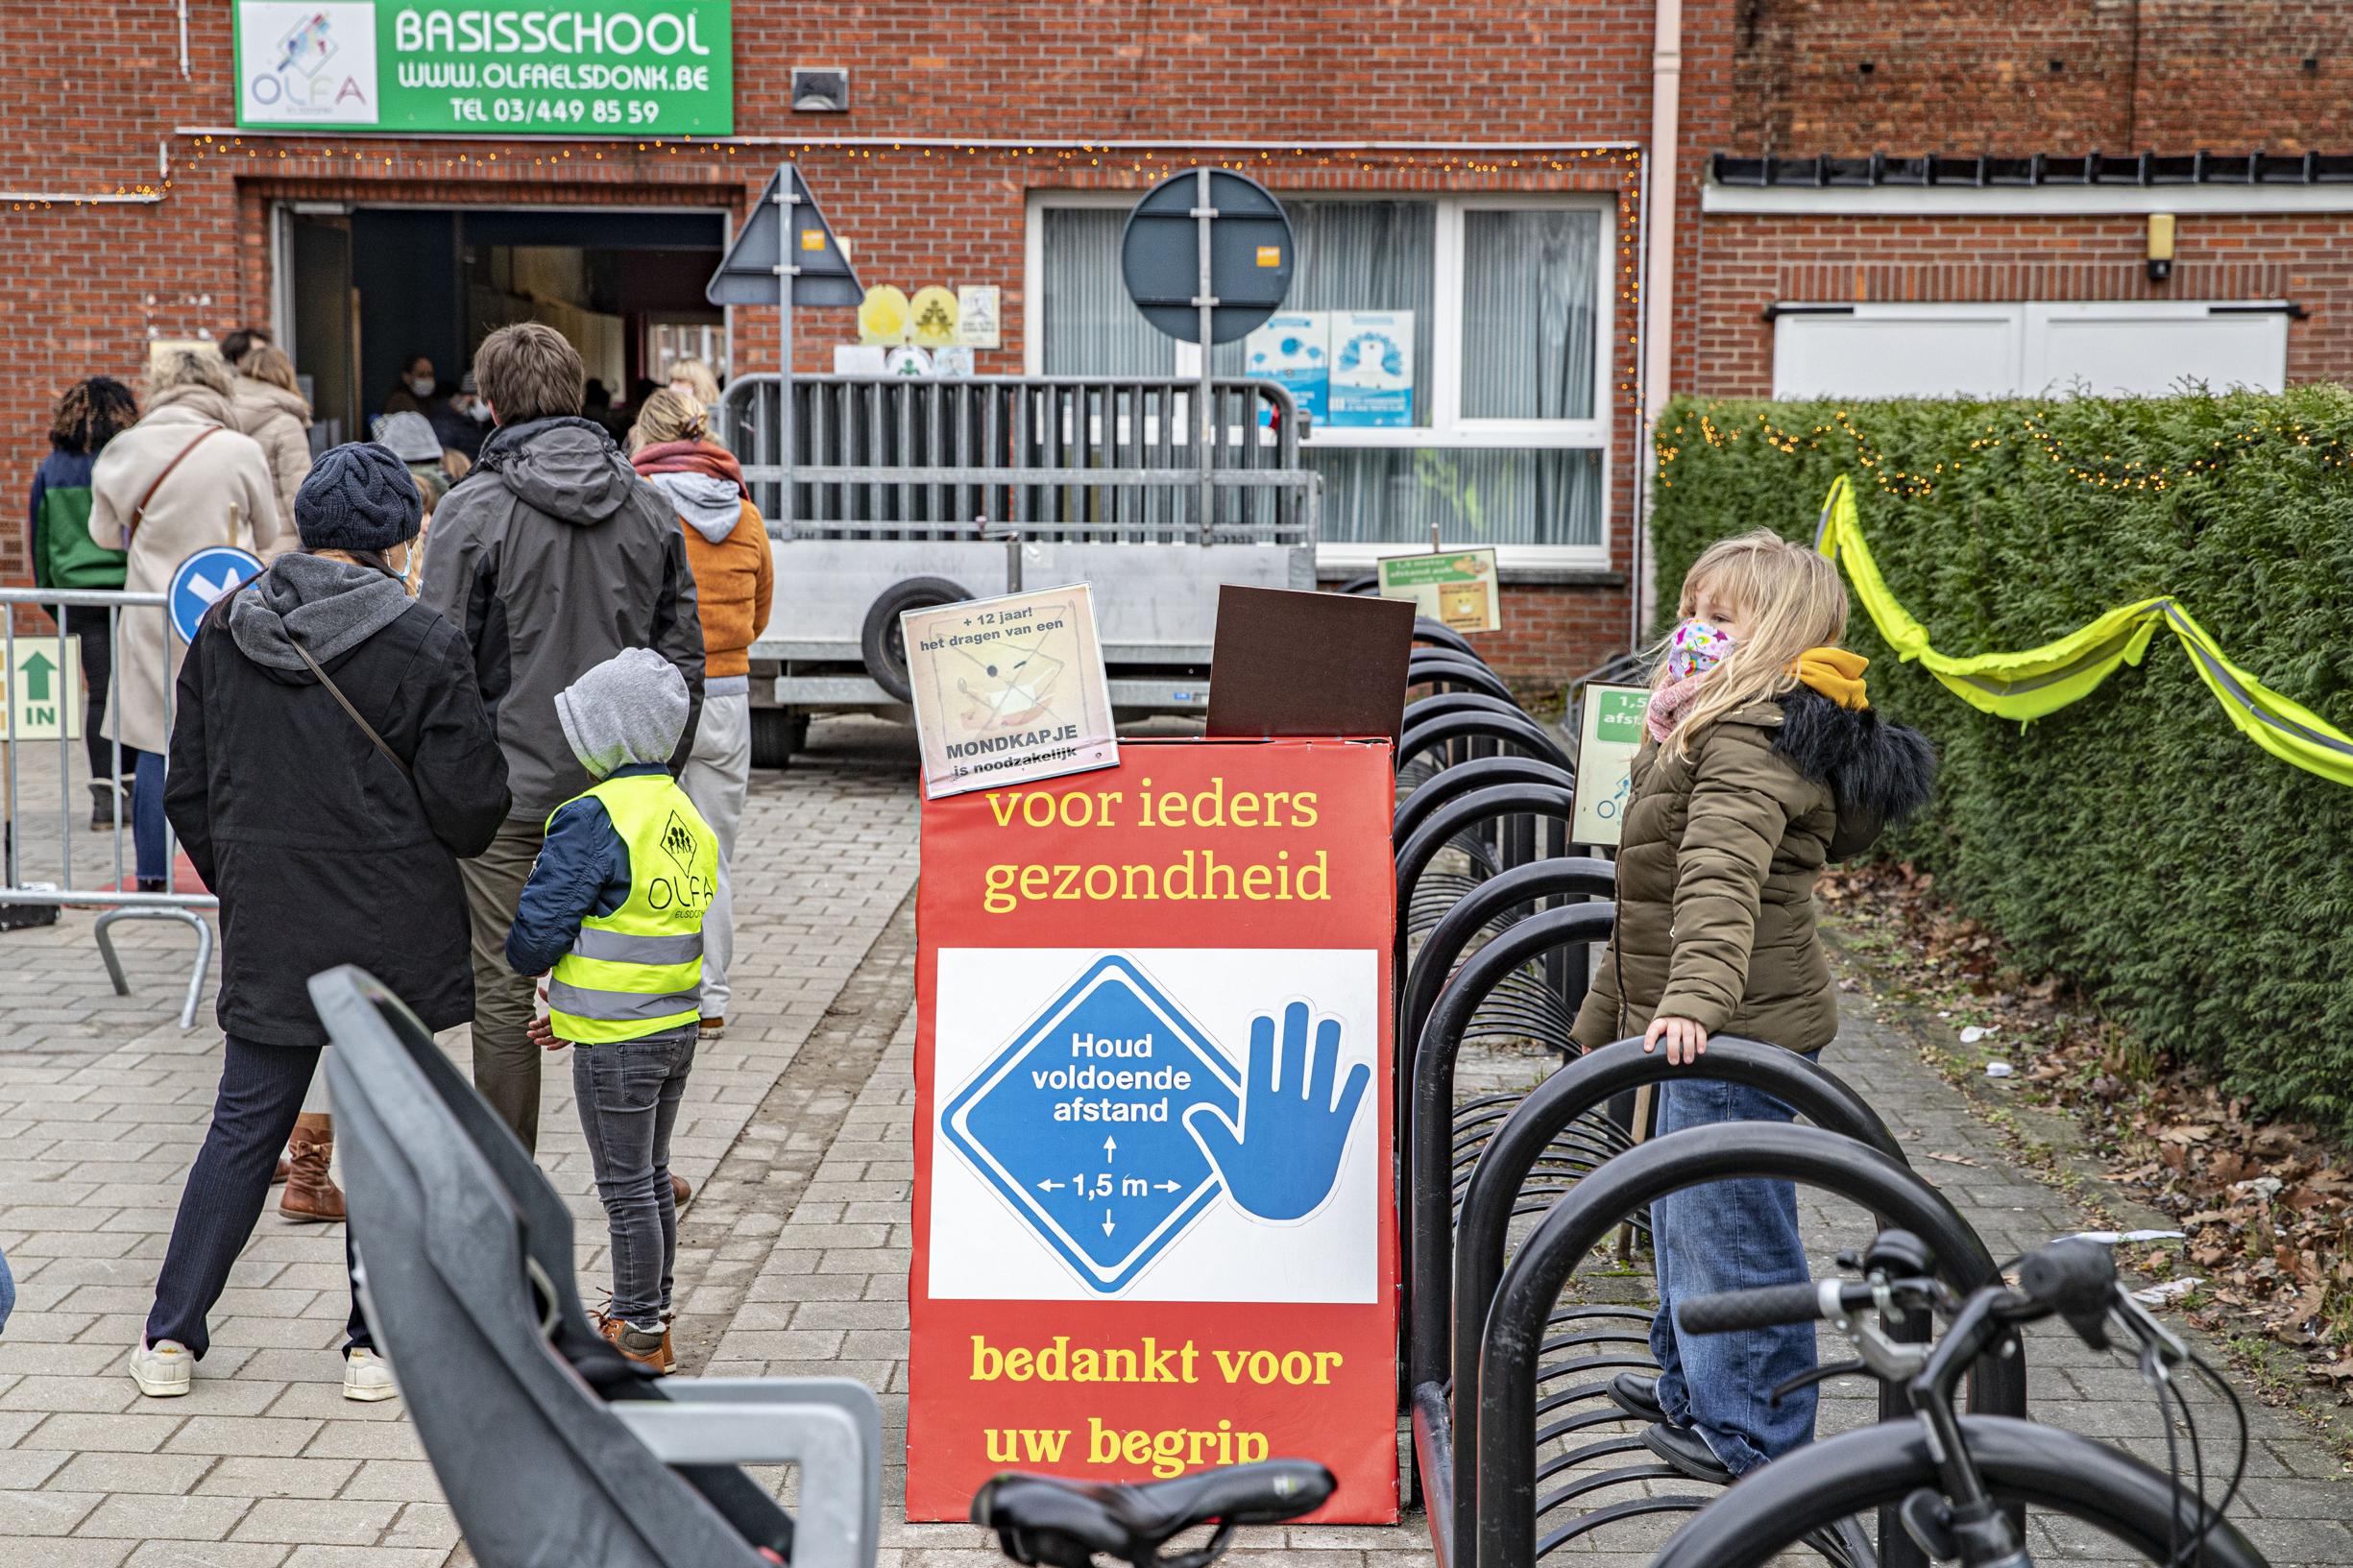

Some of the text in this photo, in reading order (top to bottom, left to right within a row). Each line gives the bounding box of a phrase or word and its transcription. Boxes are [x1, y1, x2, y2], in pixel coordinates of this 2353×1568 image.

[395, 9, 710, 56] BASISSCHOOL
[251, 73, 367, 106] OLFA
[398, 62, 709, 91] WWW.OLFAELSDONK.BE
[449, 98, 660, 124] TEL 03/449 85 59
[977, 613, 995, 625] 12
[999, 607, 1032, 624] jaar!
[920, 619, 1064, 651] het dragen van een
[26, 707, 55, 725] IN
[1619, 695, 1647, 709] 1,5
[946, 725, 1078, 760] MONDKAPJE
[954, 746, 1077, 777] is noodzakelijk
[985, 777, 1319, 828] voor ieders
[648, 875, 714, 909] OLFA
[982, 850, 1331, 914] gezondheid
[1072, 1033, 1152, 1058] Houd
[1031, 1065, 1191, 1090] voldoende
[1054, 1098, 1168, 1122] afstand
[1072, 1173, 1148, 1199] 1,5 m
[969, 1335, 1343, 1385] bedankt voor
[983, 1417, 1270, 1479] uw begrip
